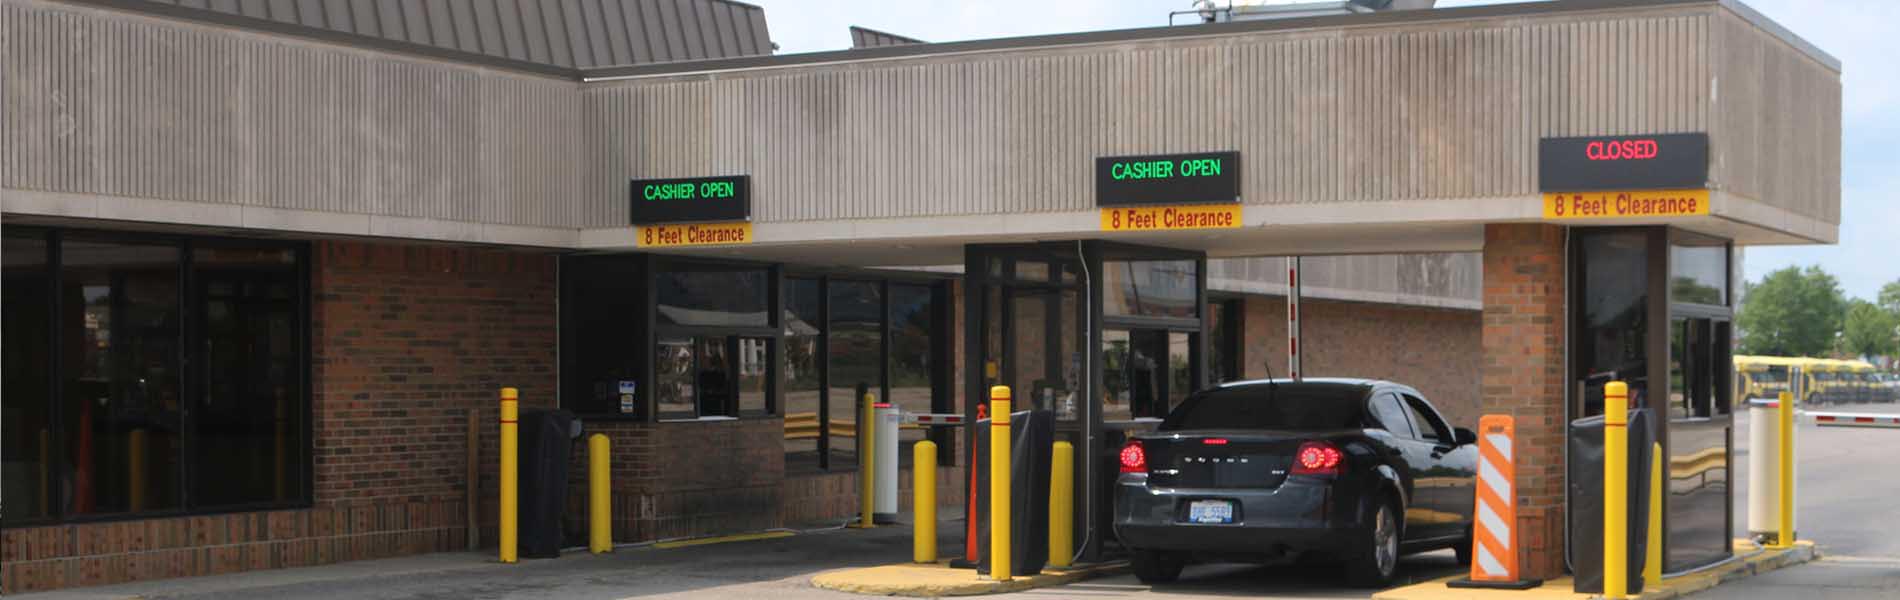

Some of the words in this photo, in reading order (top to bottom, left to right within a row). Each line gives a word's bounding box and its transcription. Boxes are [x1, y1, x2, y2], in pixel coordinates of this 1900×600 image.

[1586, 139, 1658, 160] CLOSED
[1112, 161, 1174, 180] CASHIER
[1180, 159, 1221, 177] OPEN
[644, 183, 695, 200] CASHIER
[700, 182, 734, 198] OPEN
[1554, 195, 1565, 216] 8
[1573, 194, 1607, 215] Feet
[1616, 193, 1697, 215] Clearance
[1112, 210, 1120, 229] 8
[1127, 209, 1157, 228] Feet
[1163, 208, 1233, 228] Clearance
[645, 227, 653, 245] 8
[658, 226, 682, 244] Feet
[687, 225, 744, 243] Clearance
